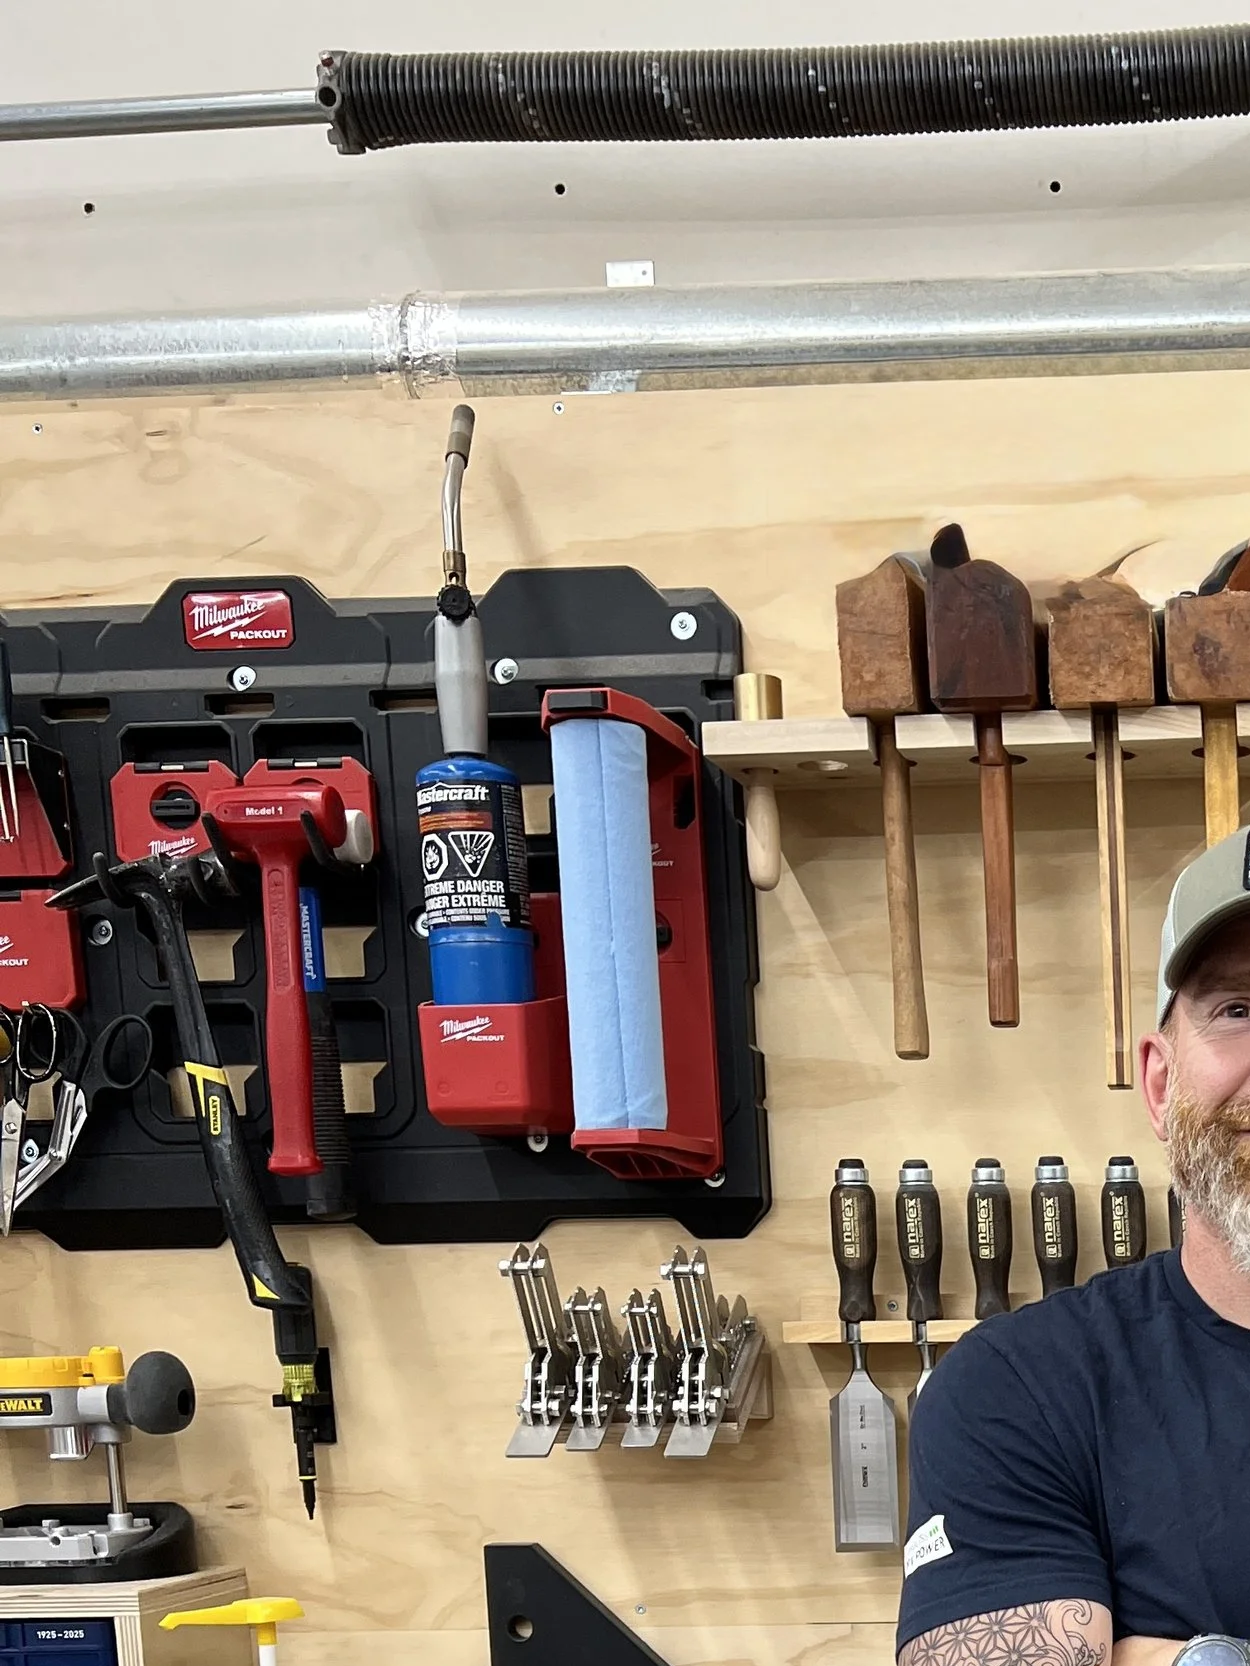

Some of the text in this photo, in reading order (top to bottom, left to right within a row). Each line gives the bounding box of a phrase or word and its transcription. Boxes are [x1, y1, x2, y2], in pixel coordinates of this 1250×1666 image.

[189, 597, 264, 630] Milwaukee
[230, 629, 287, 640] PACKOUT
[246, 807, 275, 815] Model
[149, 836, 196, 855] Milwaukee
[457, 880, 505, 894] DANGER
[452, 892, 506, 908] EXTRÊME
[301, 904, 315, 977] MASTERCRAFT
[440, 1016, 491, 1034] Milwaukee
[467, 1034, 504, 1042] PACKOUT
[211, 1098, 220, 1132] STANLEY
[842, 1198, 854, 1243] narex
[905, 1198, 919, 1243] narex
[977, 1198, 989, 1244] narex
[1043, 1197, 1056, 1243] narex
[1112, 1196, 1125, 1241] narex
[0, 1398, 43, 1411] EWALT
[916, 1536, 945, 1560] POWER
